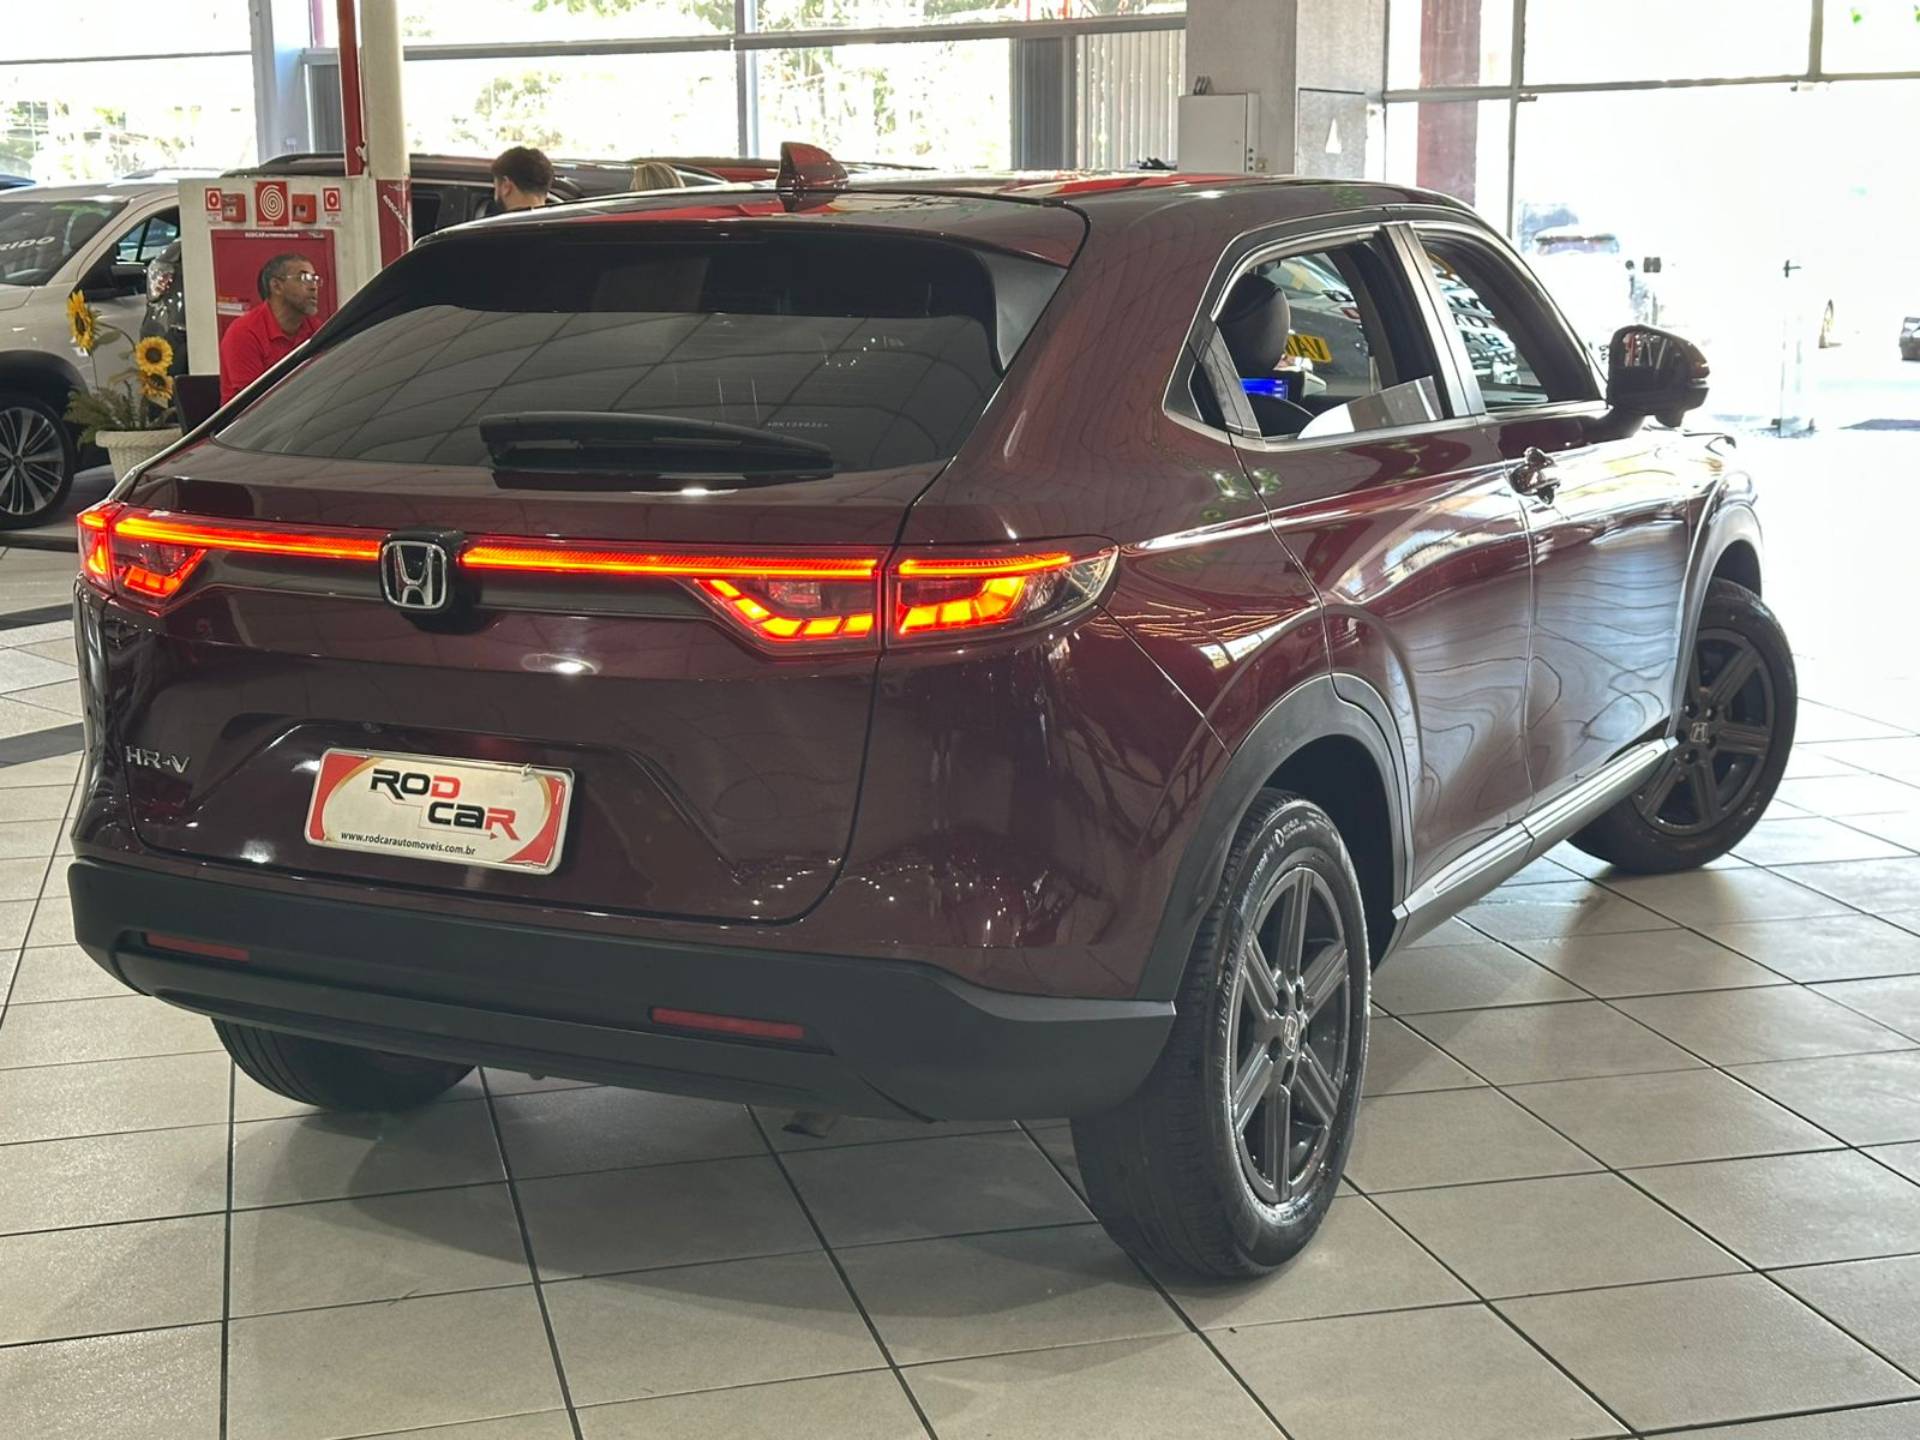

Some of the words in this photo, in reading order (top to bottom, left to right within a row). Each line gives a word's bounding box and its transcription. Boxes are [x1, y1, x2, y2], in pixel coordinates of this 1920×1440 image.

[125, 745, 190, 774] HR-V
[370, 768, 462, 800] ROD
[340, 831, 477, 856] www.rodcarautomoveis.com.br
